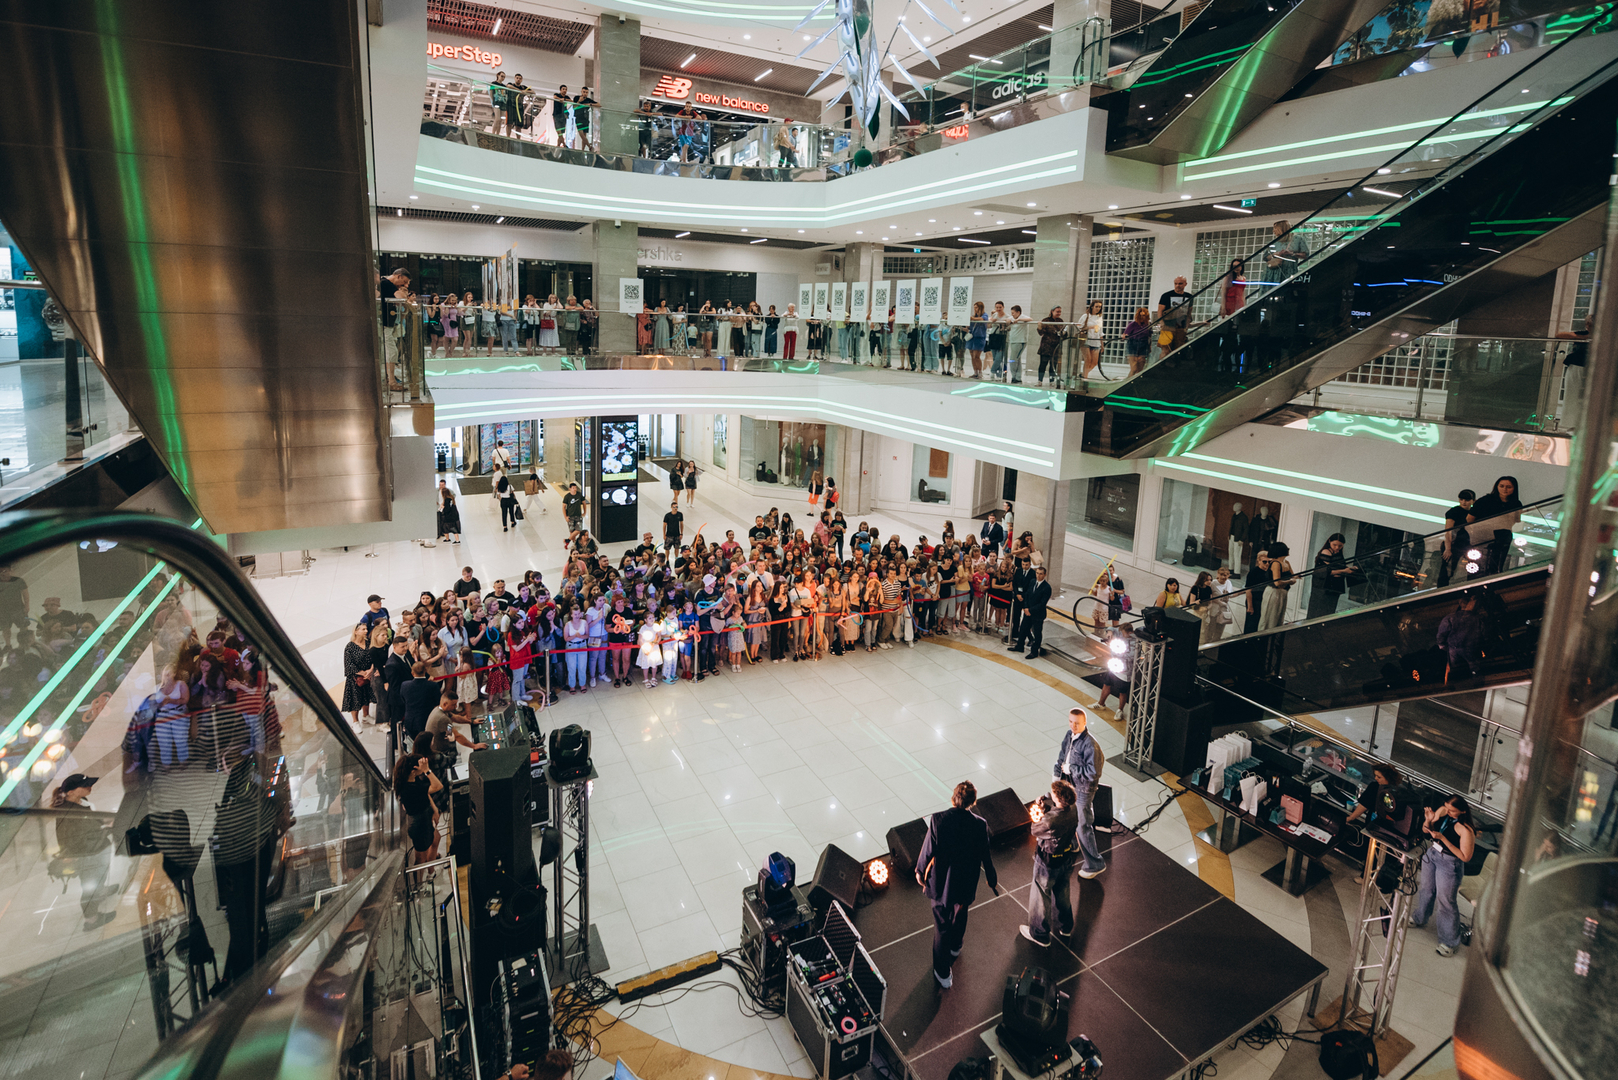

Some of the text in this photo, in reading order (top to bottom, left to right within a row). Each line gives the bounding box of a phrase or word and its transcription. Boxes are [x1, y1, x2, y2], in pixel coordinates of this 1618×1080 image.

[427, 42, 503, 69] uperStep
[695, 92, 769, 113] new balance
[637, 246, 683, 262] ershka
